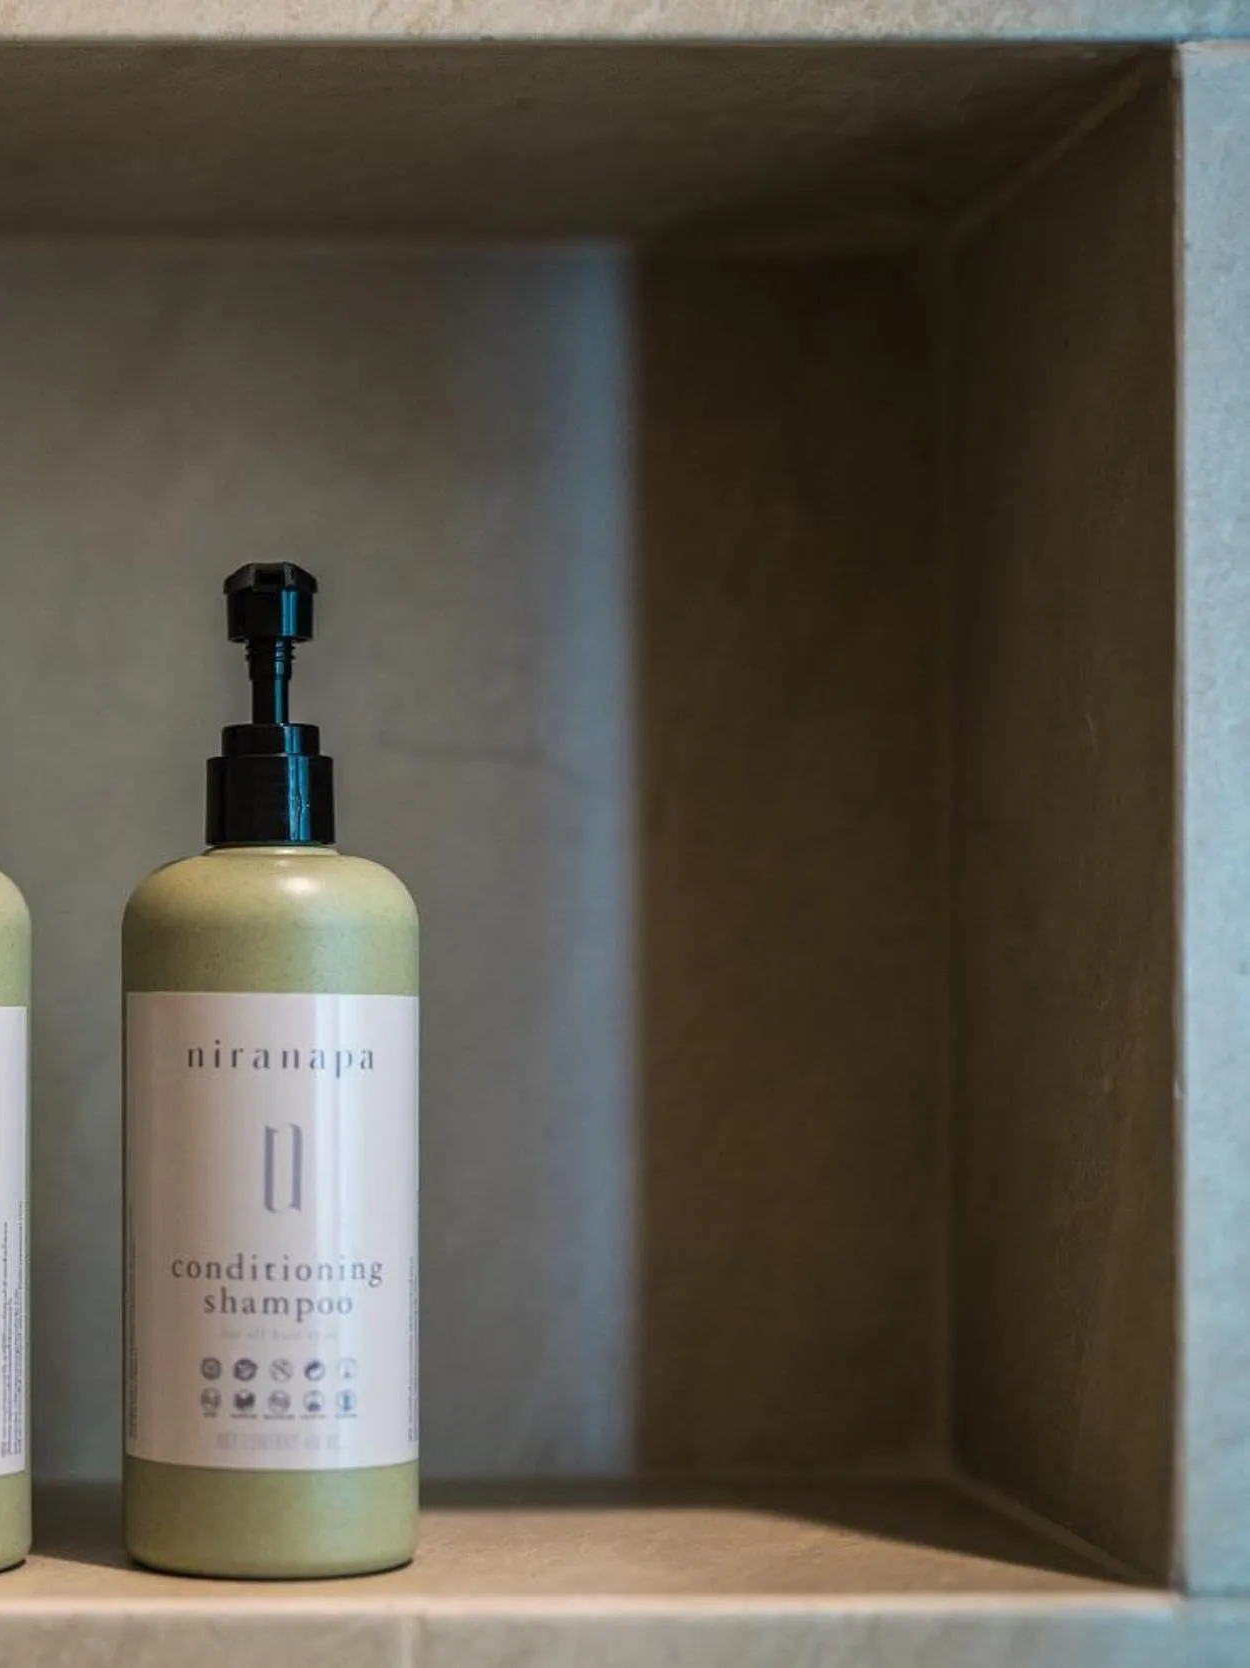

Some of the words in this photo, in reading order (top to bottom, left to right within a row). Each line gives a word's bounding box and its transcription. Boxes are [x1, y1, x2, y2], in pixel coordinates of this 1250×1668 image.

[187, 1039, 375, 1079] niranapa
[170, 1252, 384, 1288] conditioning
[202, 1285, 353, 1323] shampoo
